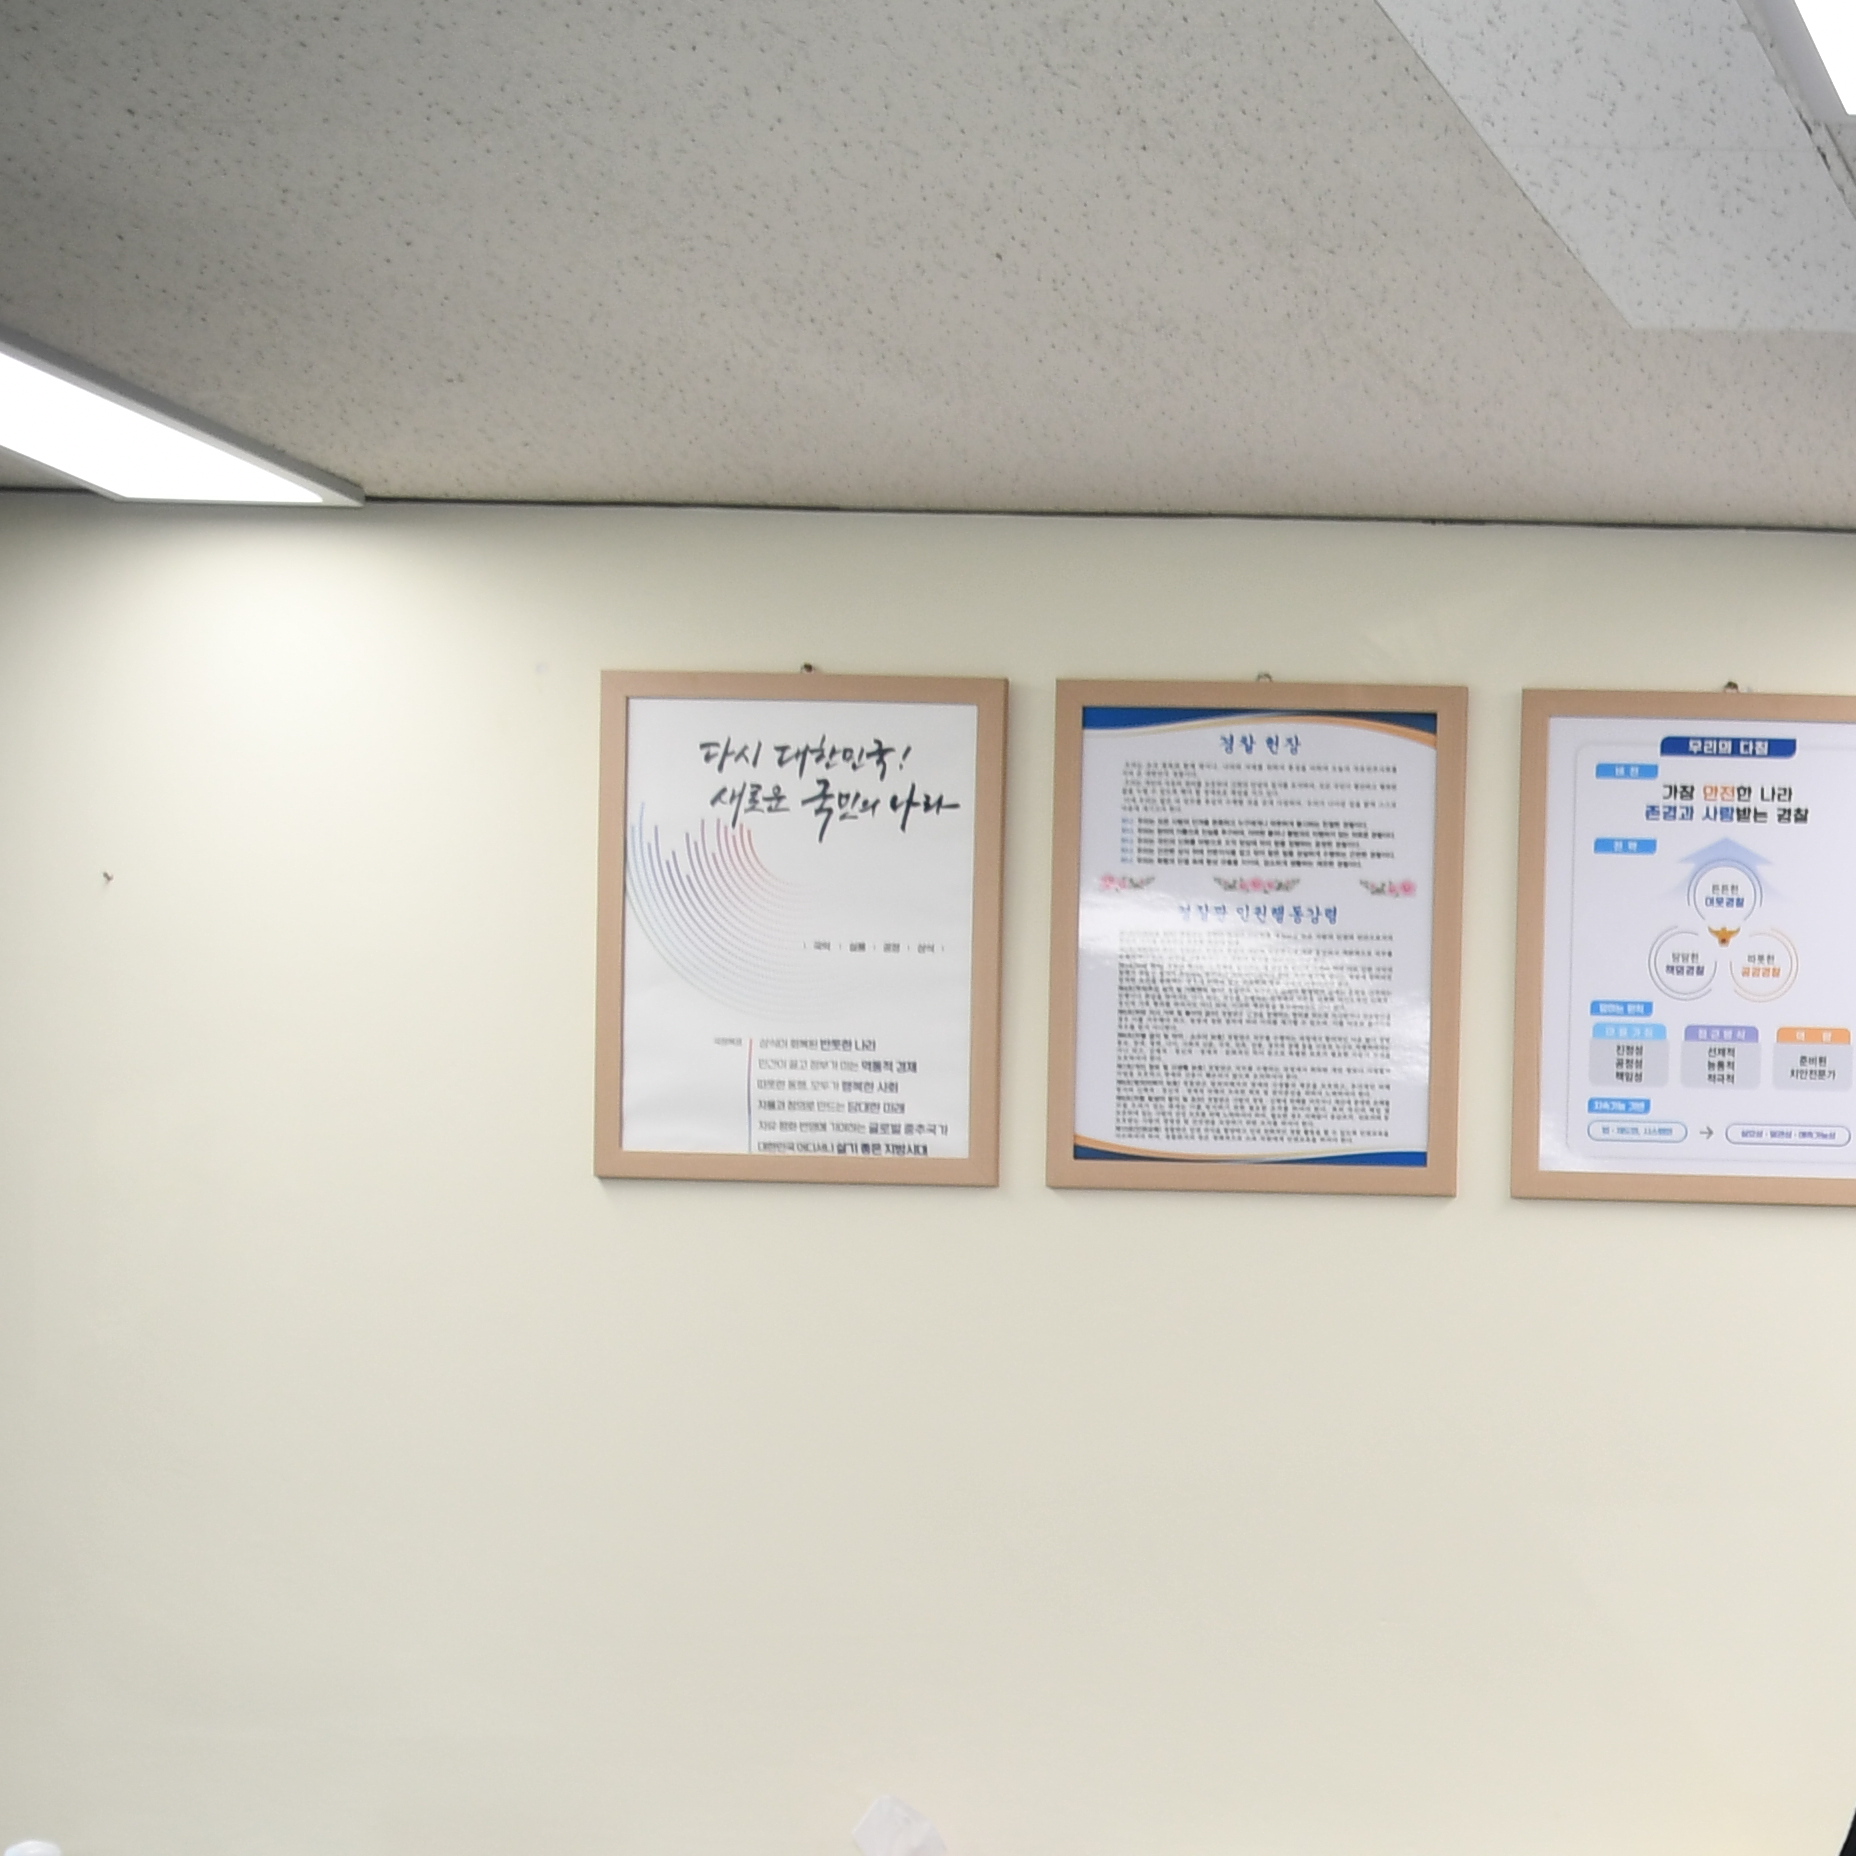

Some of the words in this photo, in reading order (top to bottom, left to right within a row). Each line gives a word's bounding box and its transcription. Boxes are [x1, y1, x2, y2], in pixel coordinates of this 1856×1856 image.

[1689, 739, 1732, 755] 우리의
[1740, 740, 1768, 756] 다짐
[700, 736, 762, 773] 다시
[774, 734, 912, 782] 대한민국!
[1663, 784, 1694, 801] 가장
[1703, 784, 1752, 802] 안전한
[1760, 786, 1792, 802] 나라
[710, 781, 790, 829] 새로운
[801, 778, 880, 843] 국민의
[890, 783, 960, 833] 나라
[1645, 805, 1694, 821] 존경과
[1702, 806, 1768, 823] 사랑받는
[1777, 807, 1809, 824] 경찰
